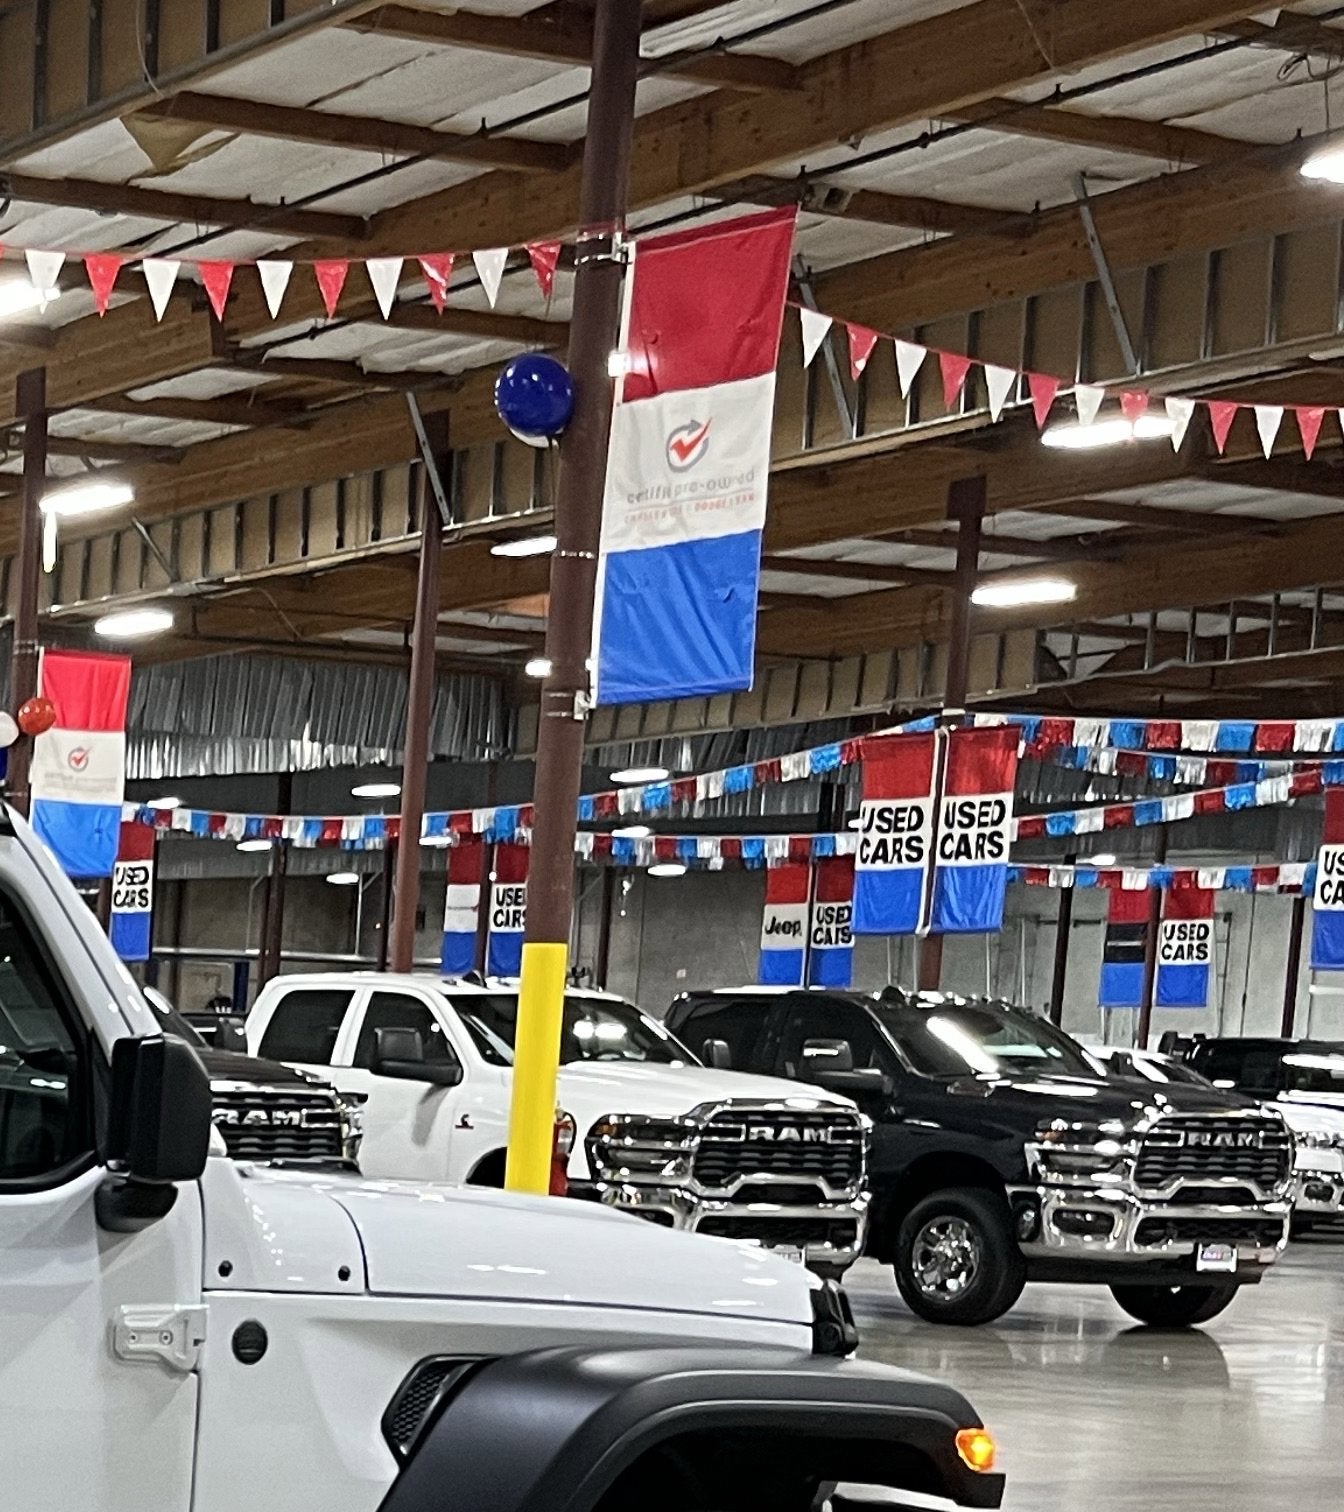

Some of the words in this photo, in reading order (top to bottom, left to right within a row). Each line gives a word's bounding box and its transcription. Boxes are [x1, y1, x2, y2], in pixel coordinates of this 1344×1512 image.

[861, 805, 924, 834] USED
[944, 799, 1007, 829] USED
[859, 835, 924, 865] CARS
[939, 830, 1004, 860] CARS
[1323, 850, 1344, 876] US
[1320, 879, 1344, 905] CA
[816, 905, 852, 925] USED
[1163, 922, 1210, 942] USED
[1161, 942, 1209, 961] CARS
[211, 1107, 301, 1126] RAM
[748, 1126, 827, 1142] RAM
[1187, 1132, 1259, 1147] RAM
